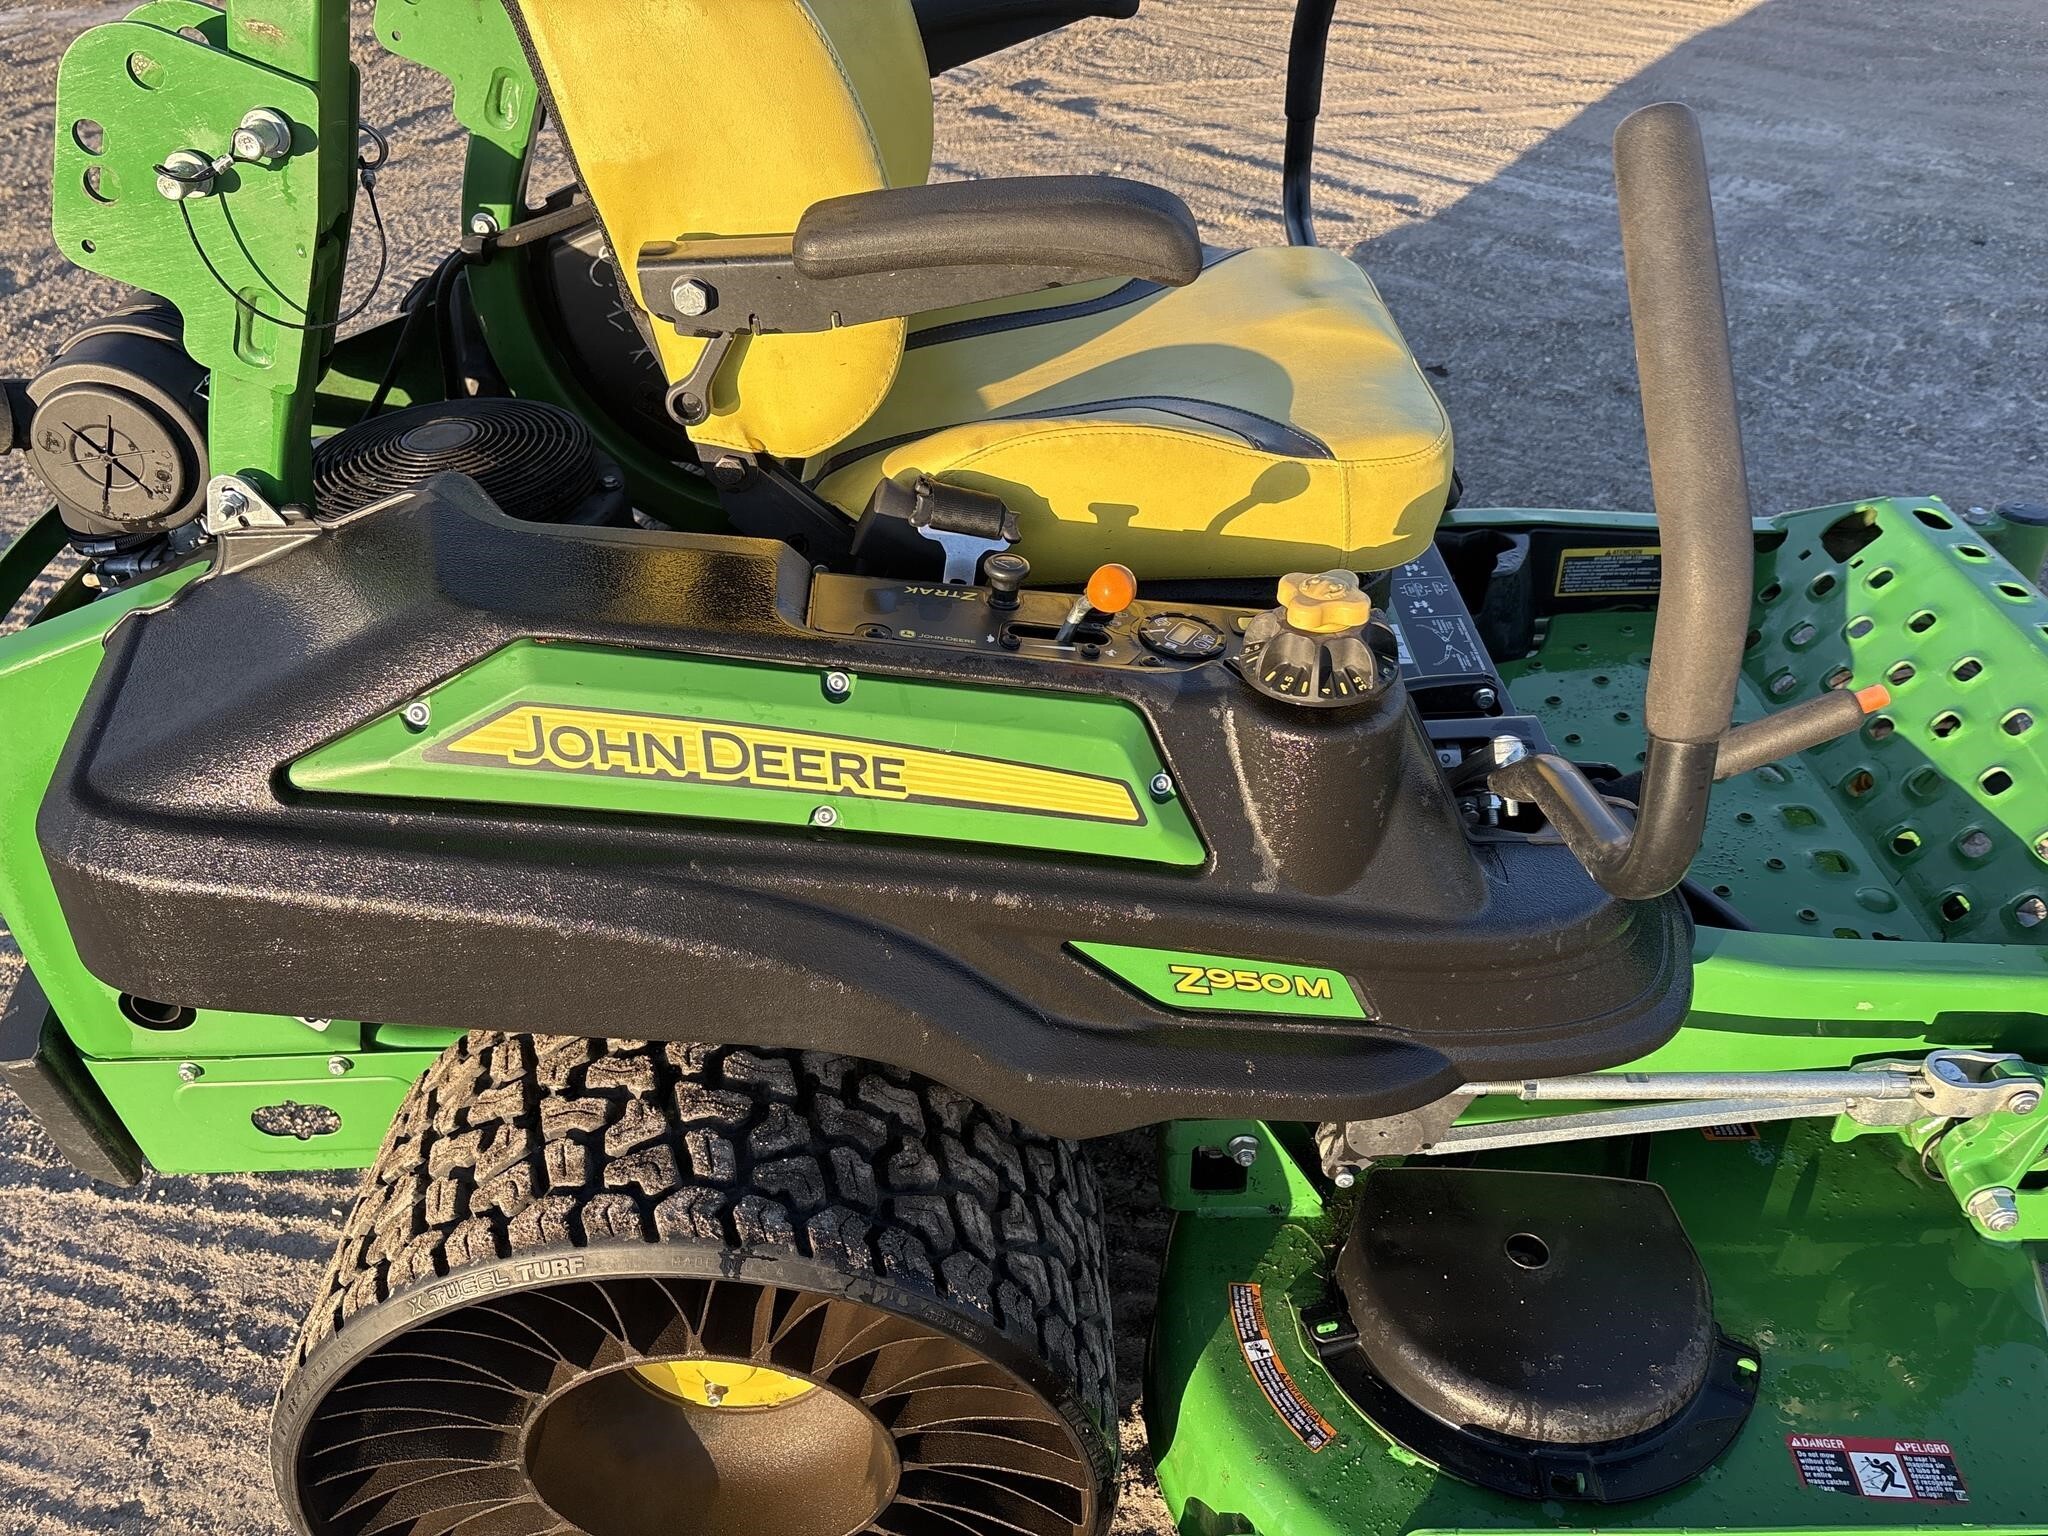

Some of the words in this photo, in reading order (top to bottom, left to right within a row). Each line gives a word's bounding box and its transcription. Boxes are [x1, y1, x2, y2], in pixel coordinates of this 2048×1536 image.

[903, 586, 978, 601] ZTRAK
[918, 633, 944, 641] JOHN
[513, 715, 686, 772] JOHN
[700, 729, 907, 793] DEERE
[1168, 964, 1333, 999] Z950M
[515, 1256, 585, 1282] TURF
[1285, 1378, 1319, 1420] ADVERTENCIA
[1801, 1438, 1846, 1449] DANGER
[1904, 1443, 1950, 1453] PELIGRO
